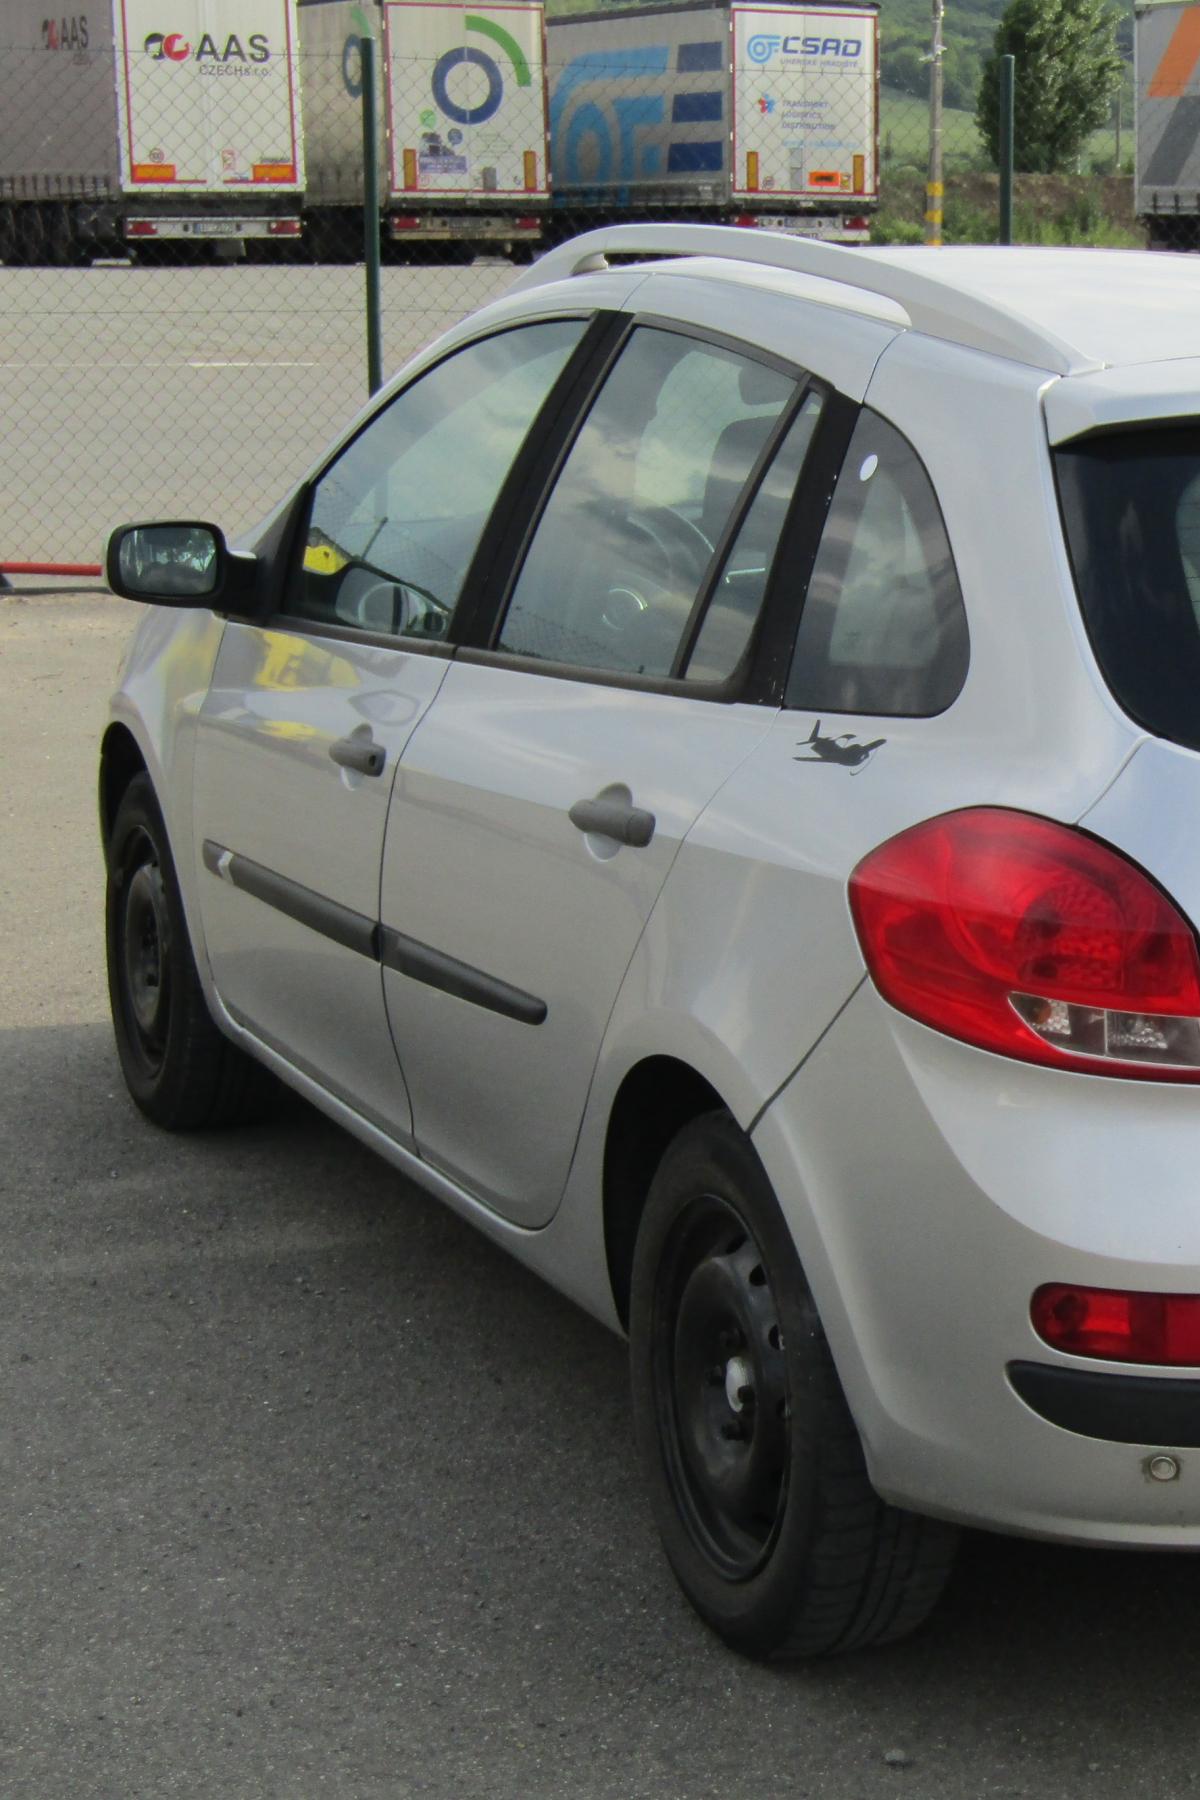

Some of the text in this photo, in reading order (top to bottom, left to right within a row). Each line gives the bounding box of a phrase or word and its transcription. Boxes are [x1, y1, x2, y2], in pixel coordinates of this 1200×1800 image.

[61, 15, 89, 50] AAS
[195, 33, 271, 63] AAS
[199, 64, 242, 76] CZECH
